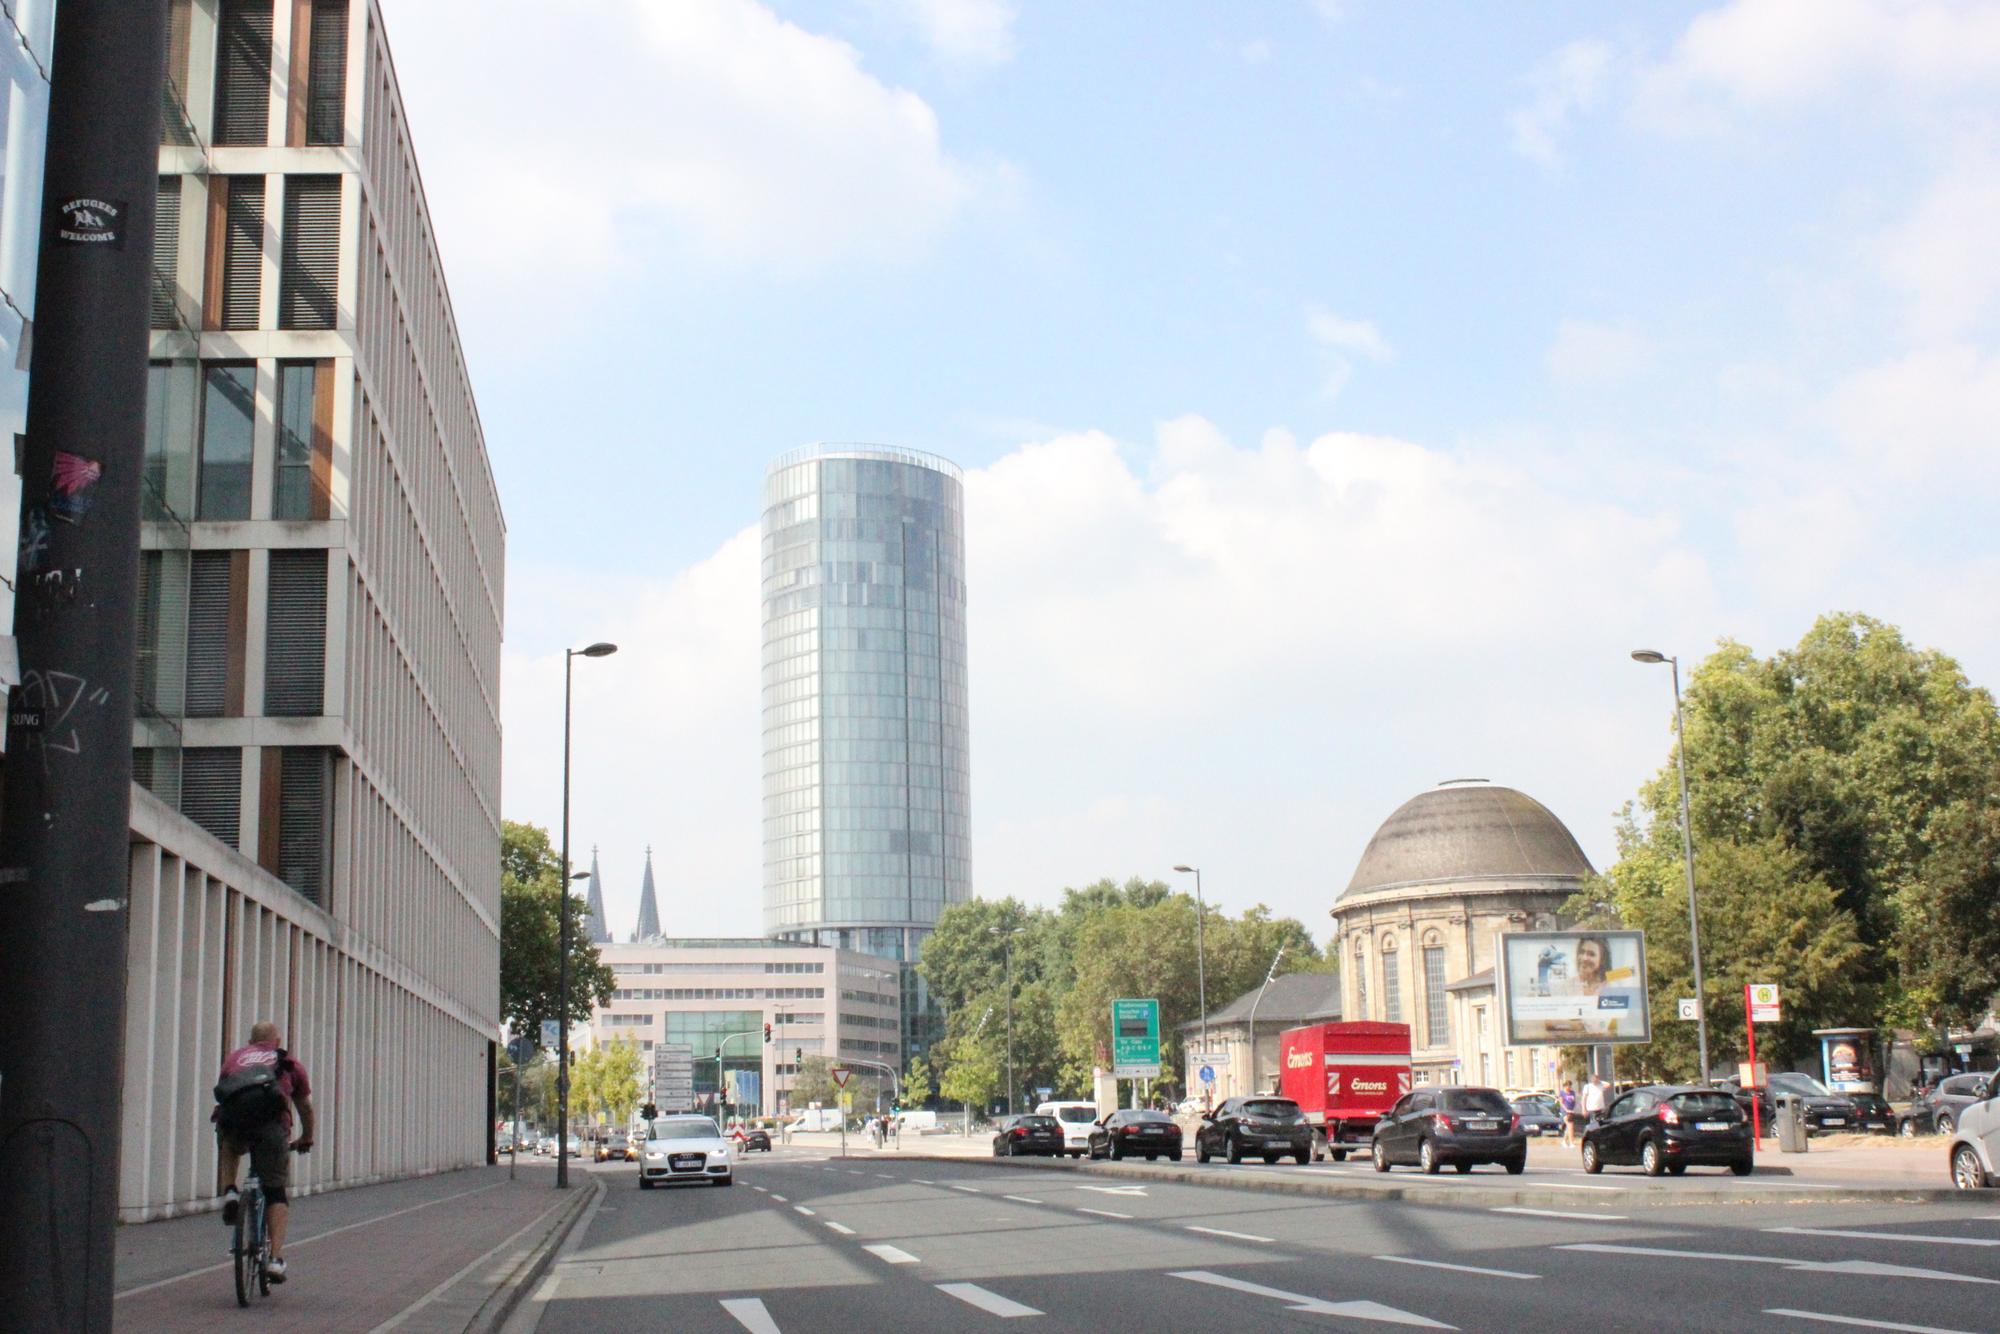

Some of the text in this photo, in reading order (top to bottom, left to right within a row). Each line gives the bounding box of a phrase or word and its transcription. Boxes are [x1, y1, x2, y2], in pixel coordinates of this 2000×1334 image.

[62, 199, 118, 216] REFUGEES
[60, 229, 115, 241] WELCOME
[1682, 1005, 1692, 1017] C
[1287, 1046, 1313, 1069] Emons
[1350, 1077, 1387, 1091] Emons
